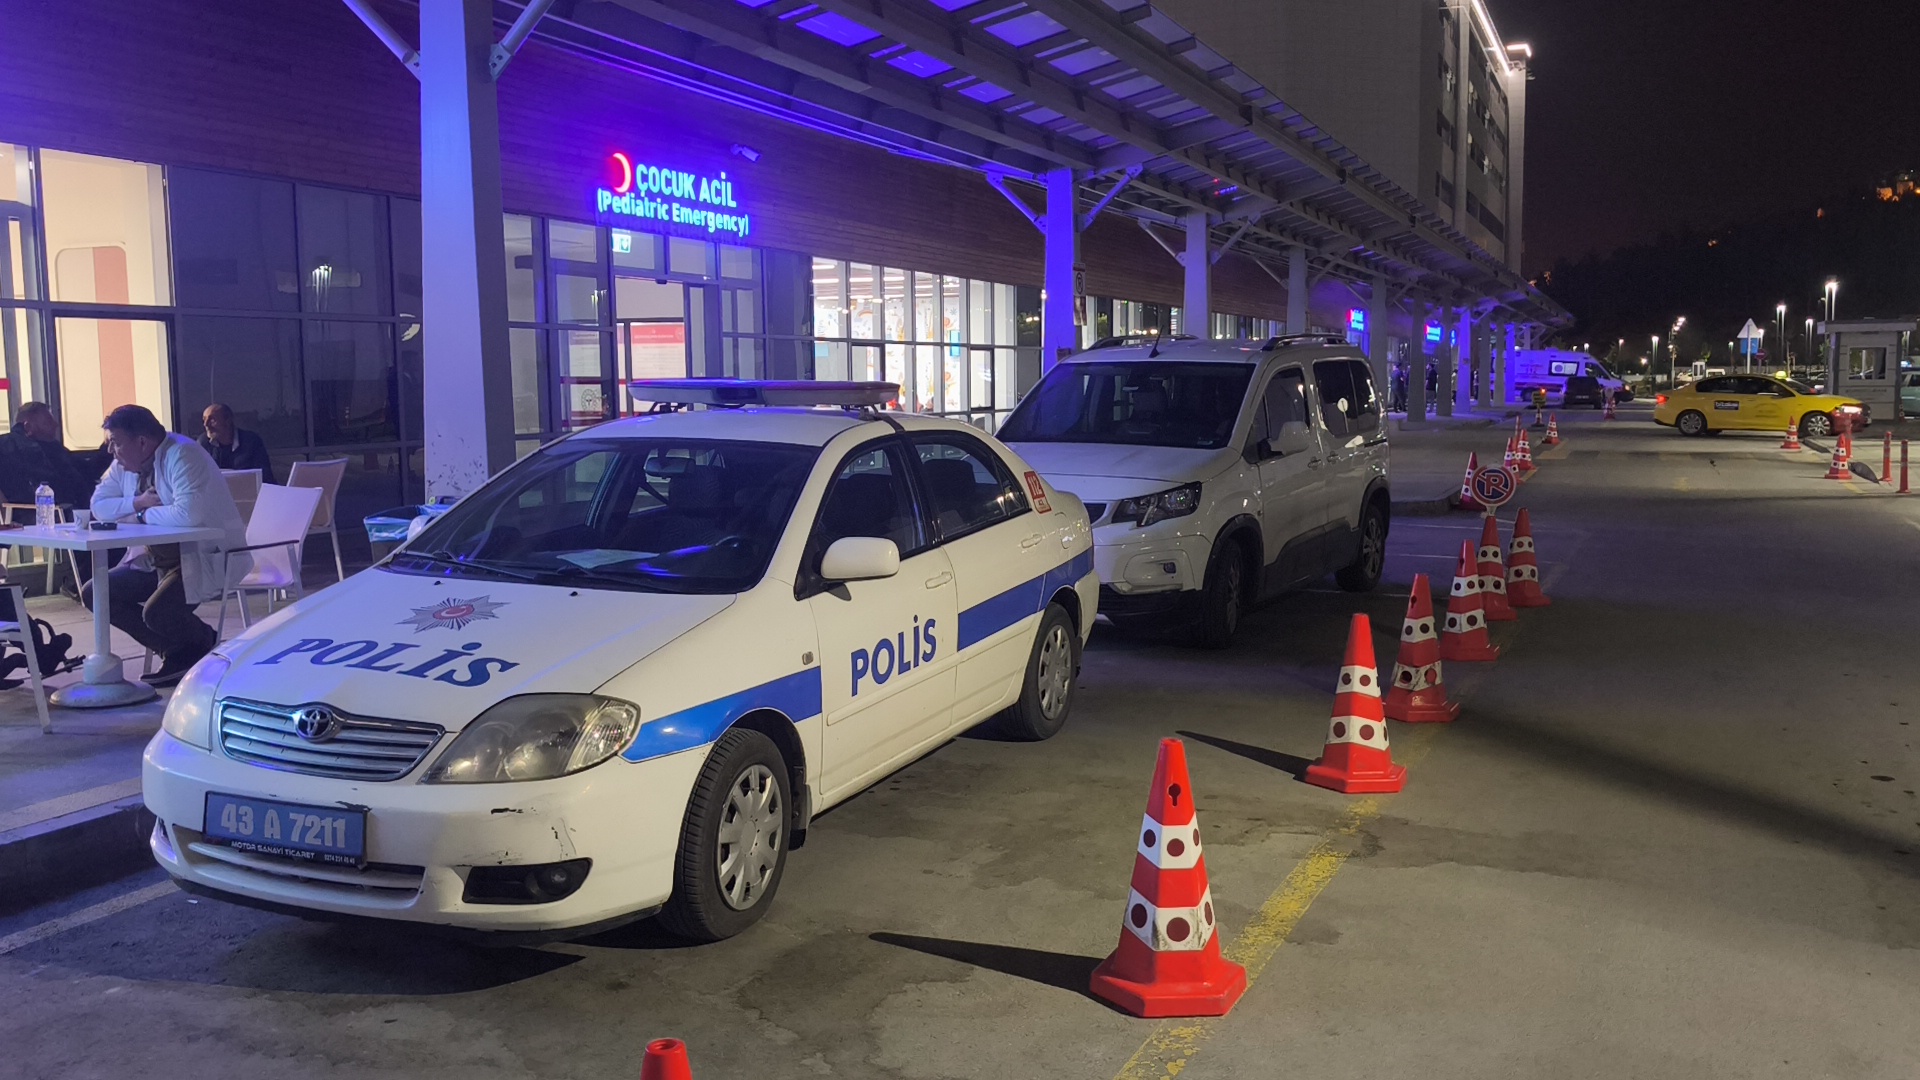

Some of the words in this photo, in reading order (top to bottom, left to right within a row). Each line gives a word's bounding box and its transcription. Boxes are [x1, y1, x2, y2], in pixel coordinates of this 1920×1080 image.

[636, 164, 696, 200] ÇOCUK
[699, 171, 737, 208] ACİL
[597, 188, 669, 220] (Pediatric
[672, 203, 749, 237] Emergency)
[252, 638, 521, 687] POLİS
[852, 614, 937, 697] POLİS
[221, 803, 254, 836] 43
[264, 809, 281, 840] A
[289, 813, 346, 849] 7211
[231, 841, 256, 851] MOTOR
